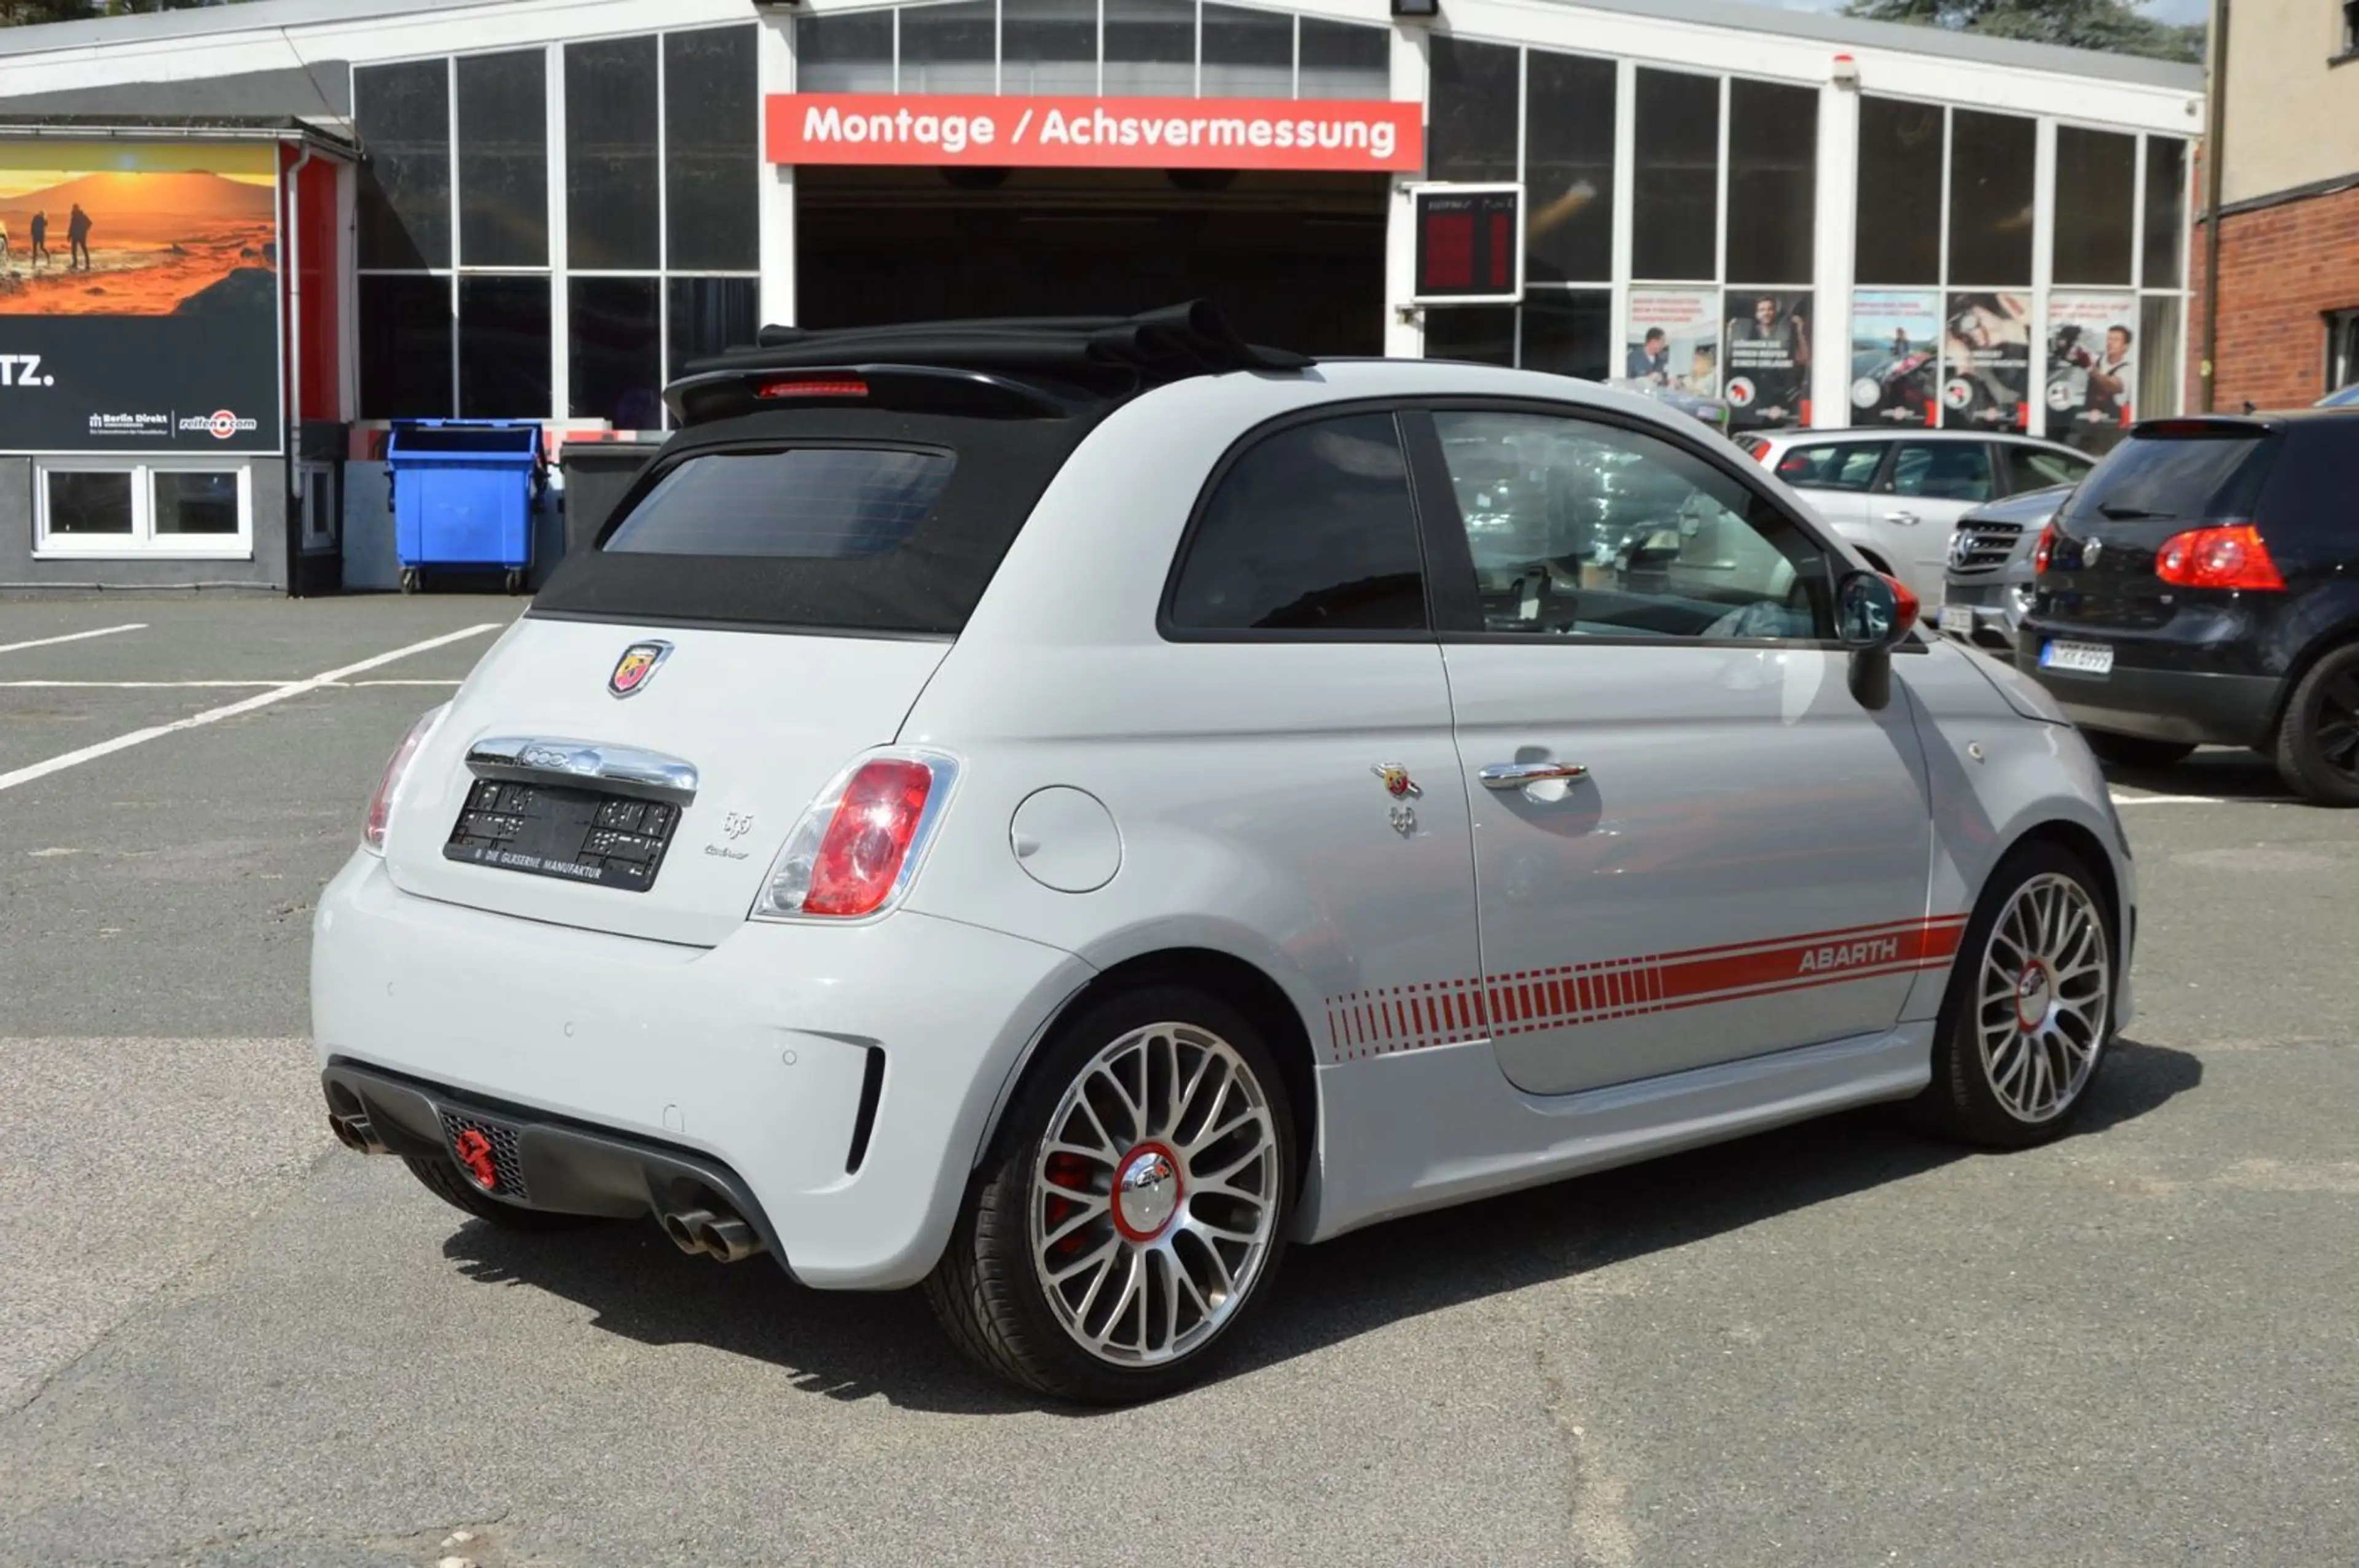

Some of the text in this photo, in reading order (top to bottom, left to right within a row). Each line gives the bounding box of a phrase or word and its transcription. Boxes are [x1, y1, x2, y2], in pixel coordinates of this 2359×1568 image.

[803, 106, 995, 153] Montage
[1039, 107, 1396, 158] Achsvermessung
[103, 413, 134, 424] Berlin
[543, 859, 602, 879] MANUFAKTUR
[1798, 937, 1898, 973] ABARTH
